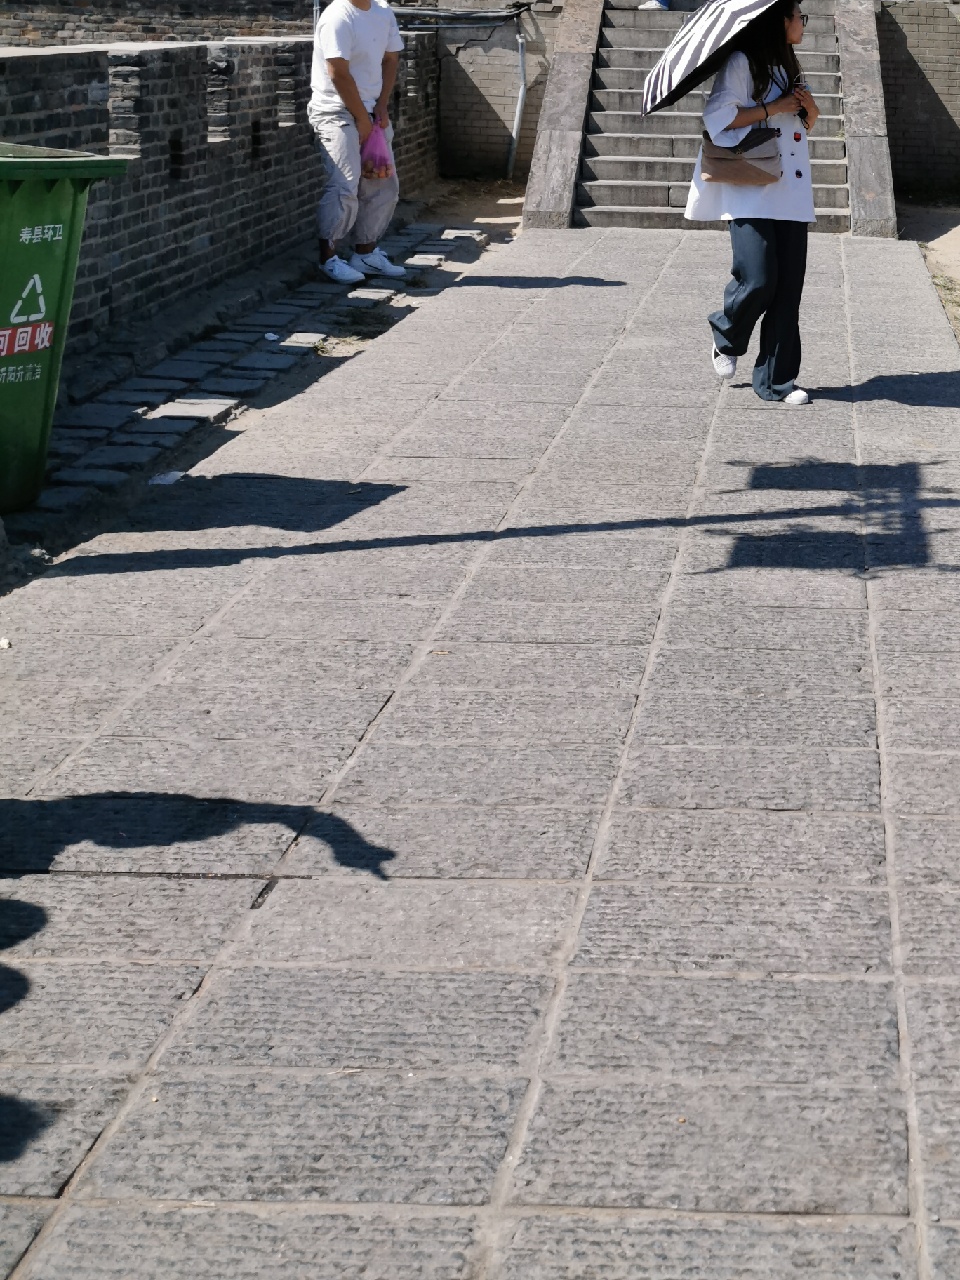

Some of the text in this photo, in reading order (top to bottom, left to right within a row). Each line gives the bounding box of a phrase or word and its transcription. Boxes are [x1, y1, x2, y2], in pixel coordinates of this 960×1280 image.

[19, 224, 63, 245] 寿县环卫
[0, 323, 53, 357] 可回收
